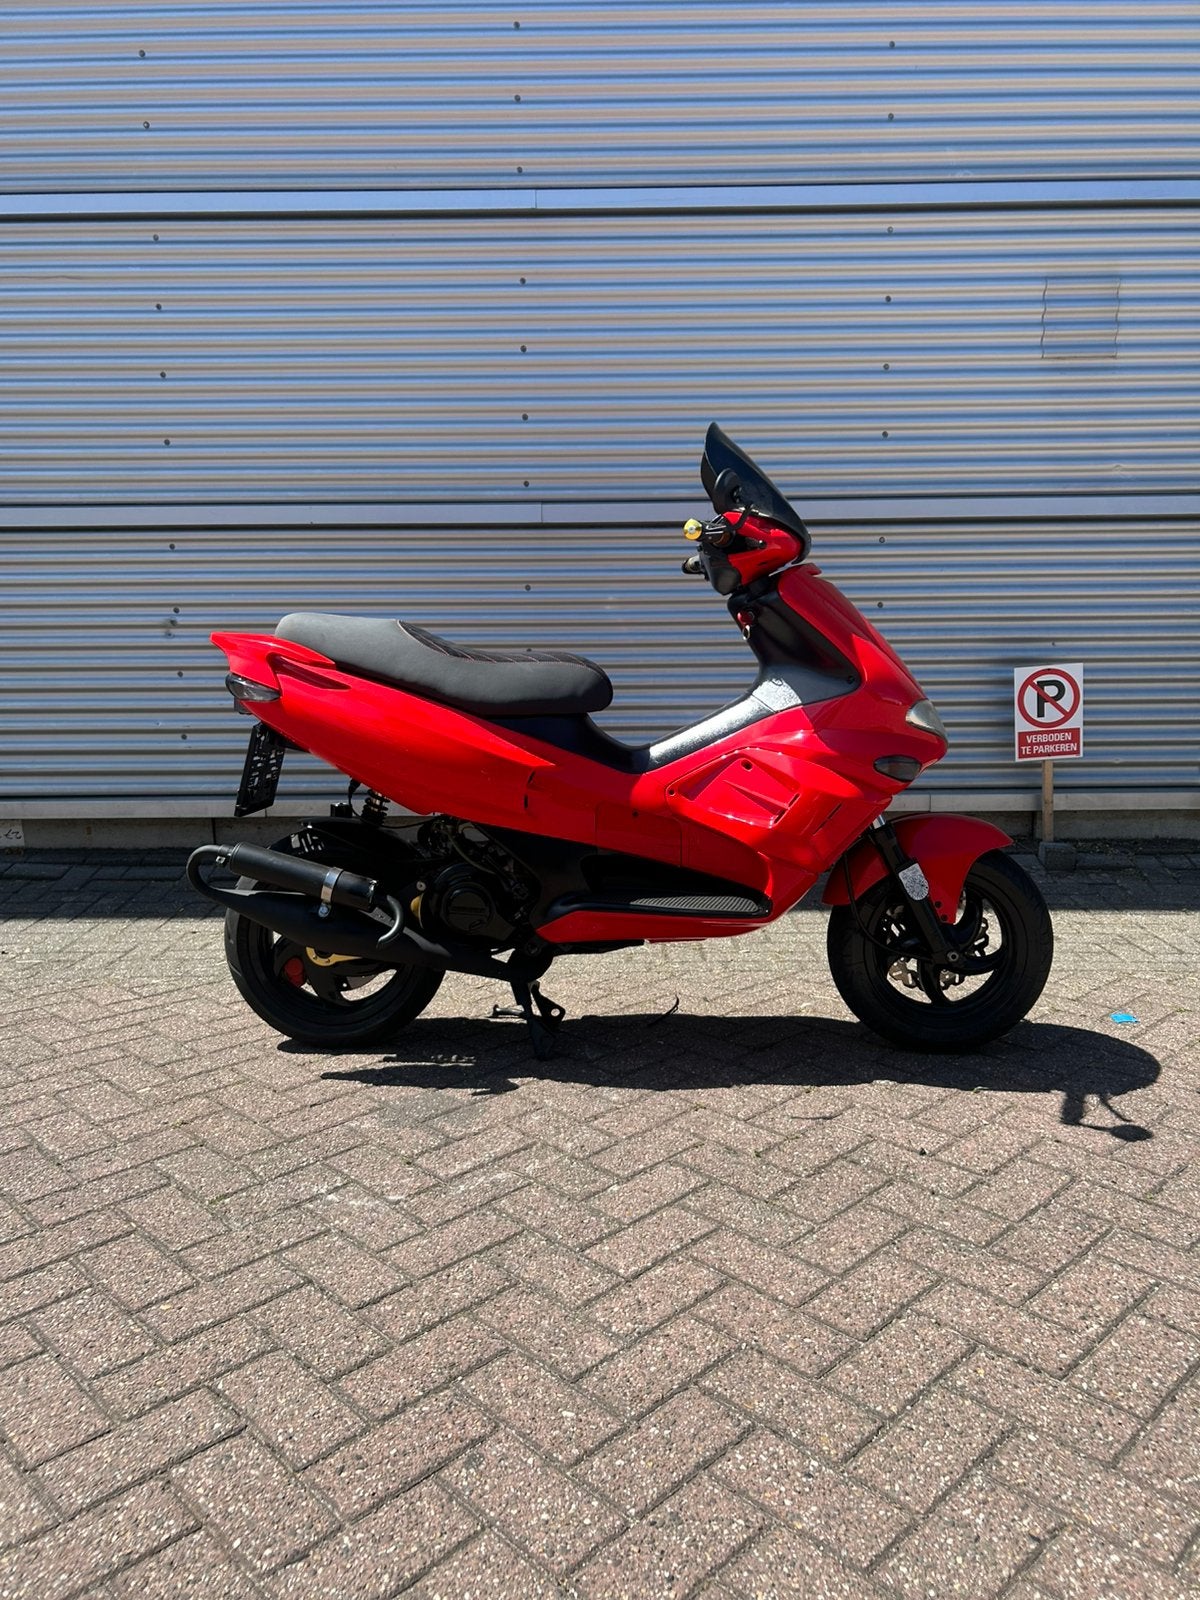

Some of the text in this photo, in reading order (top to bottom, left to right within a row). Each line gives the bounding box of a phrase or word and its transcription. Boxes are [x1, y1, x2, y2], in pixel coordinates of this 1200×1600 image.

[1037, 680, 1065, 718] P
[1026, 732, 1072, 743] VERBODEN
[1021, 743, 1077, 755] TE PARKEREN
